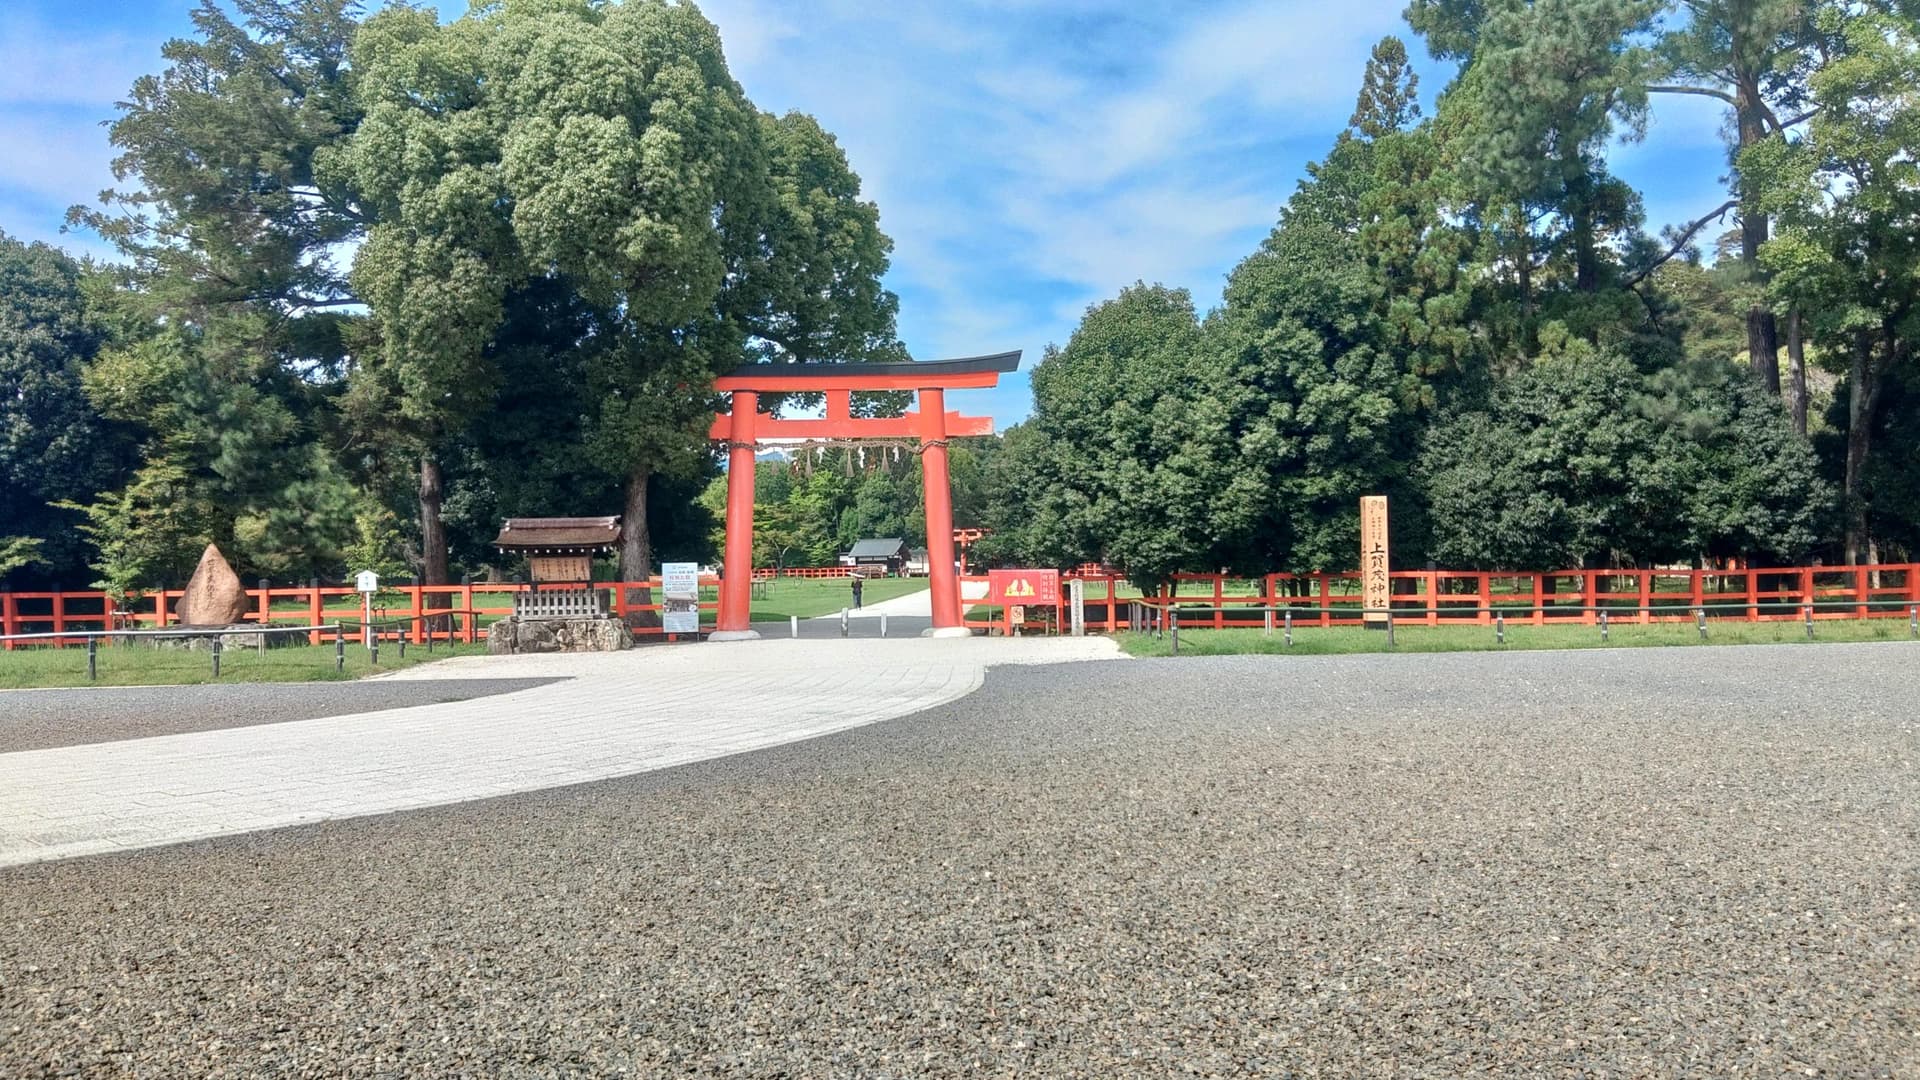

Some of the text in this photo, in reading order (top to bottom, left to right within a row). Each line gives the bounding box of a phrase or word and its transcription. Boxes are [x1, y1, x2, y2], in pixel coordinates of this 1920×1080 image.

[1370, 542, 1387, 608] 上賀茂神社
